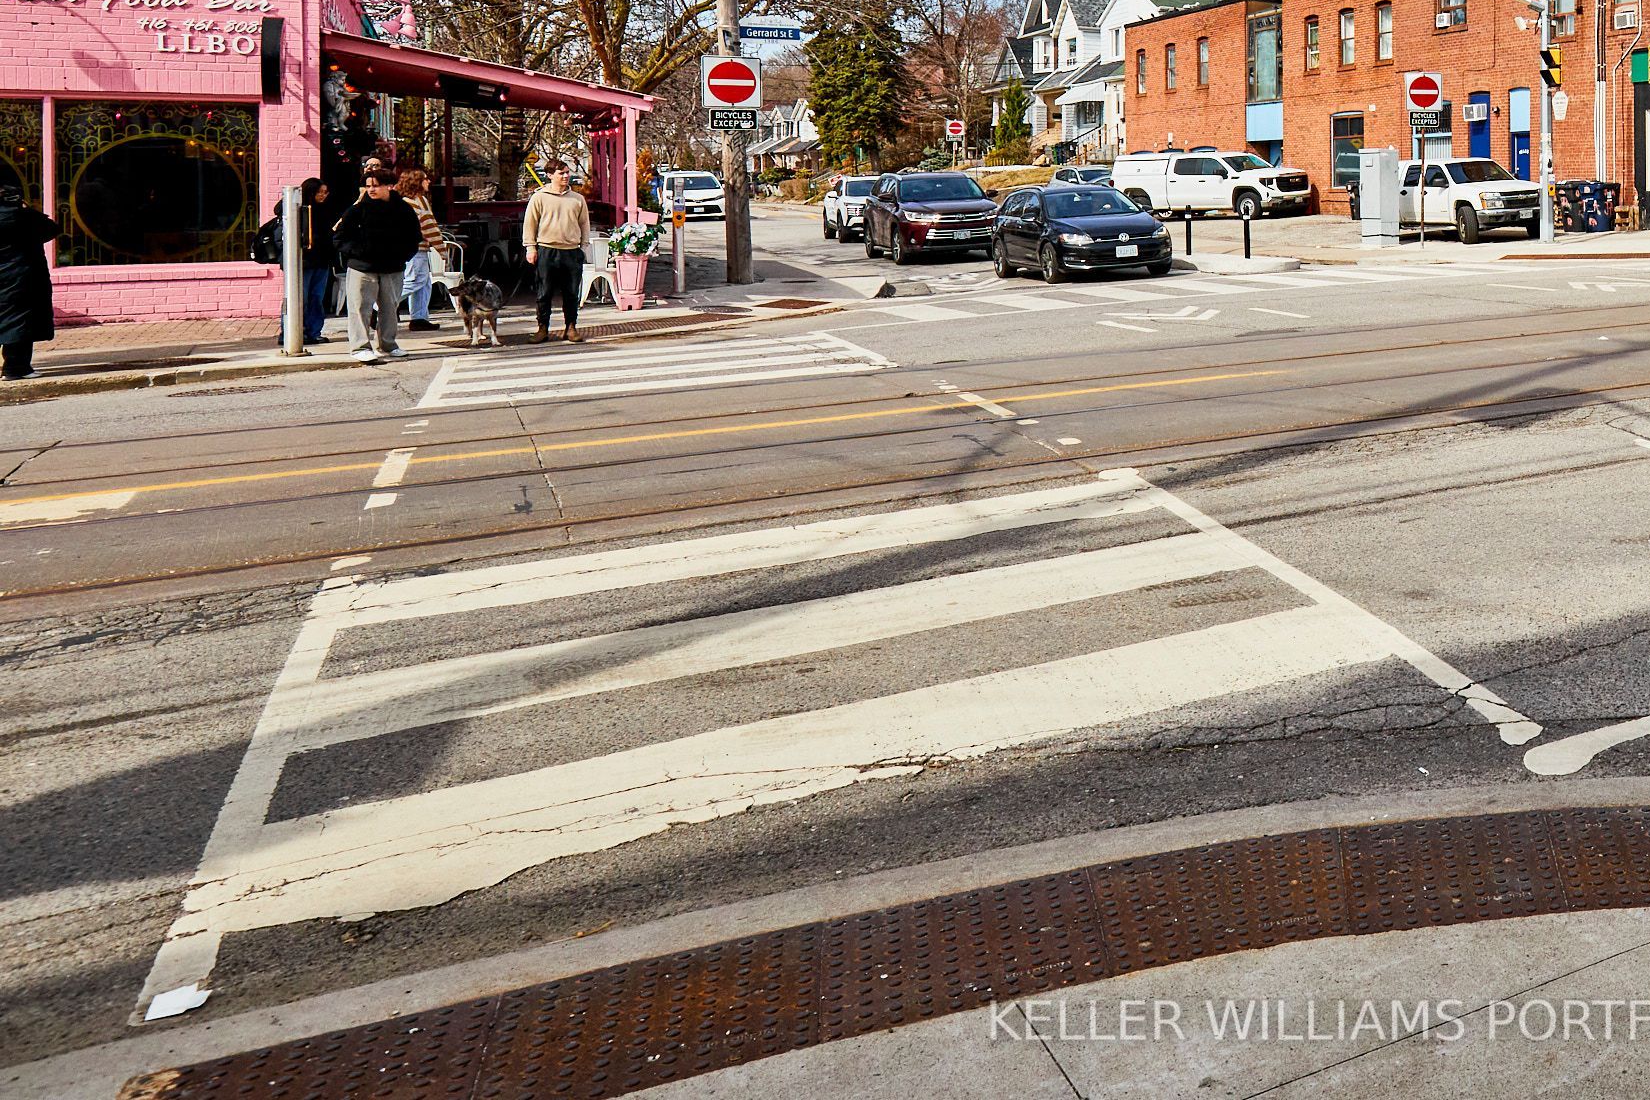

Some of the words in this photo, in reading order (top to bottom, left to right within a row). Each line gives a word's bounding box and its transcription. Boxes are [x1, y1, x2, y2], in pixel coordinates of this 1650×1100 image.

[746, 28, 778, 38] Gerrard
[779, 30, 787, 38] St
[155, 32, 256, 56] LLBO
[715, 111, 752, 119] BICYCLES
